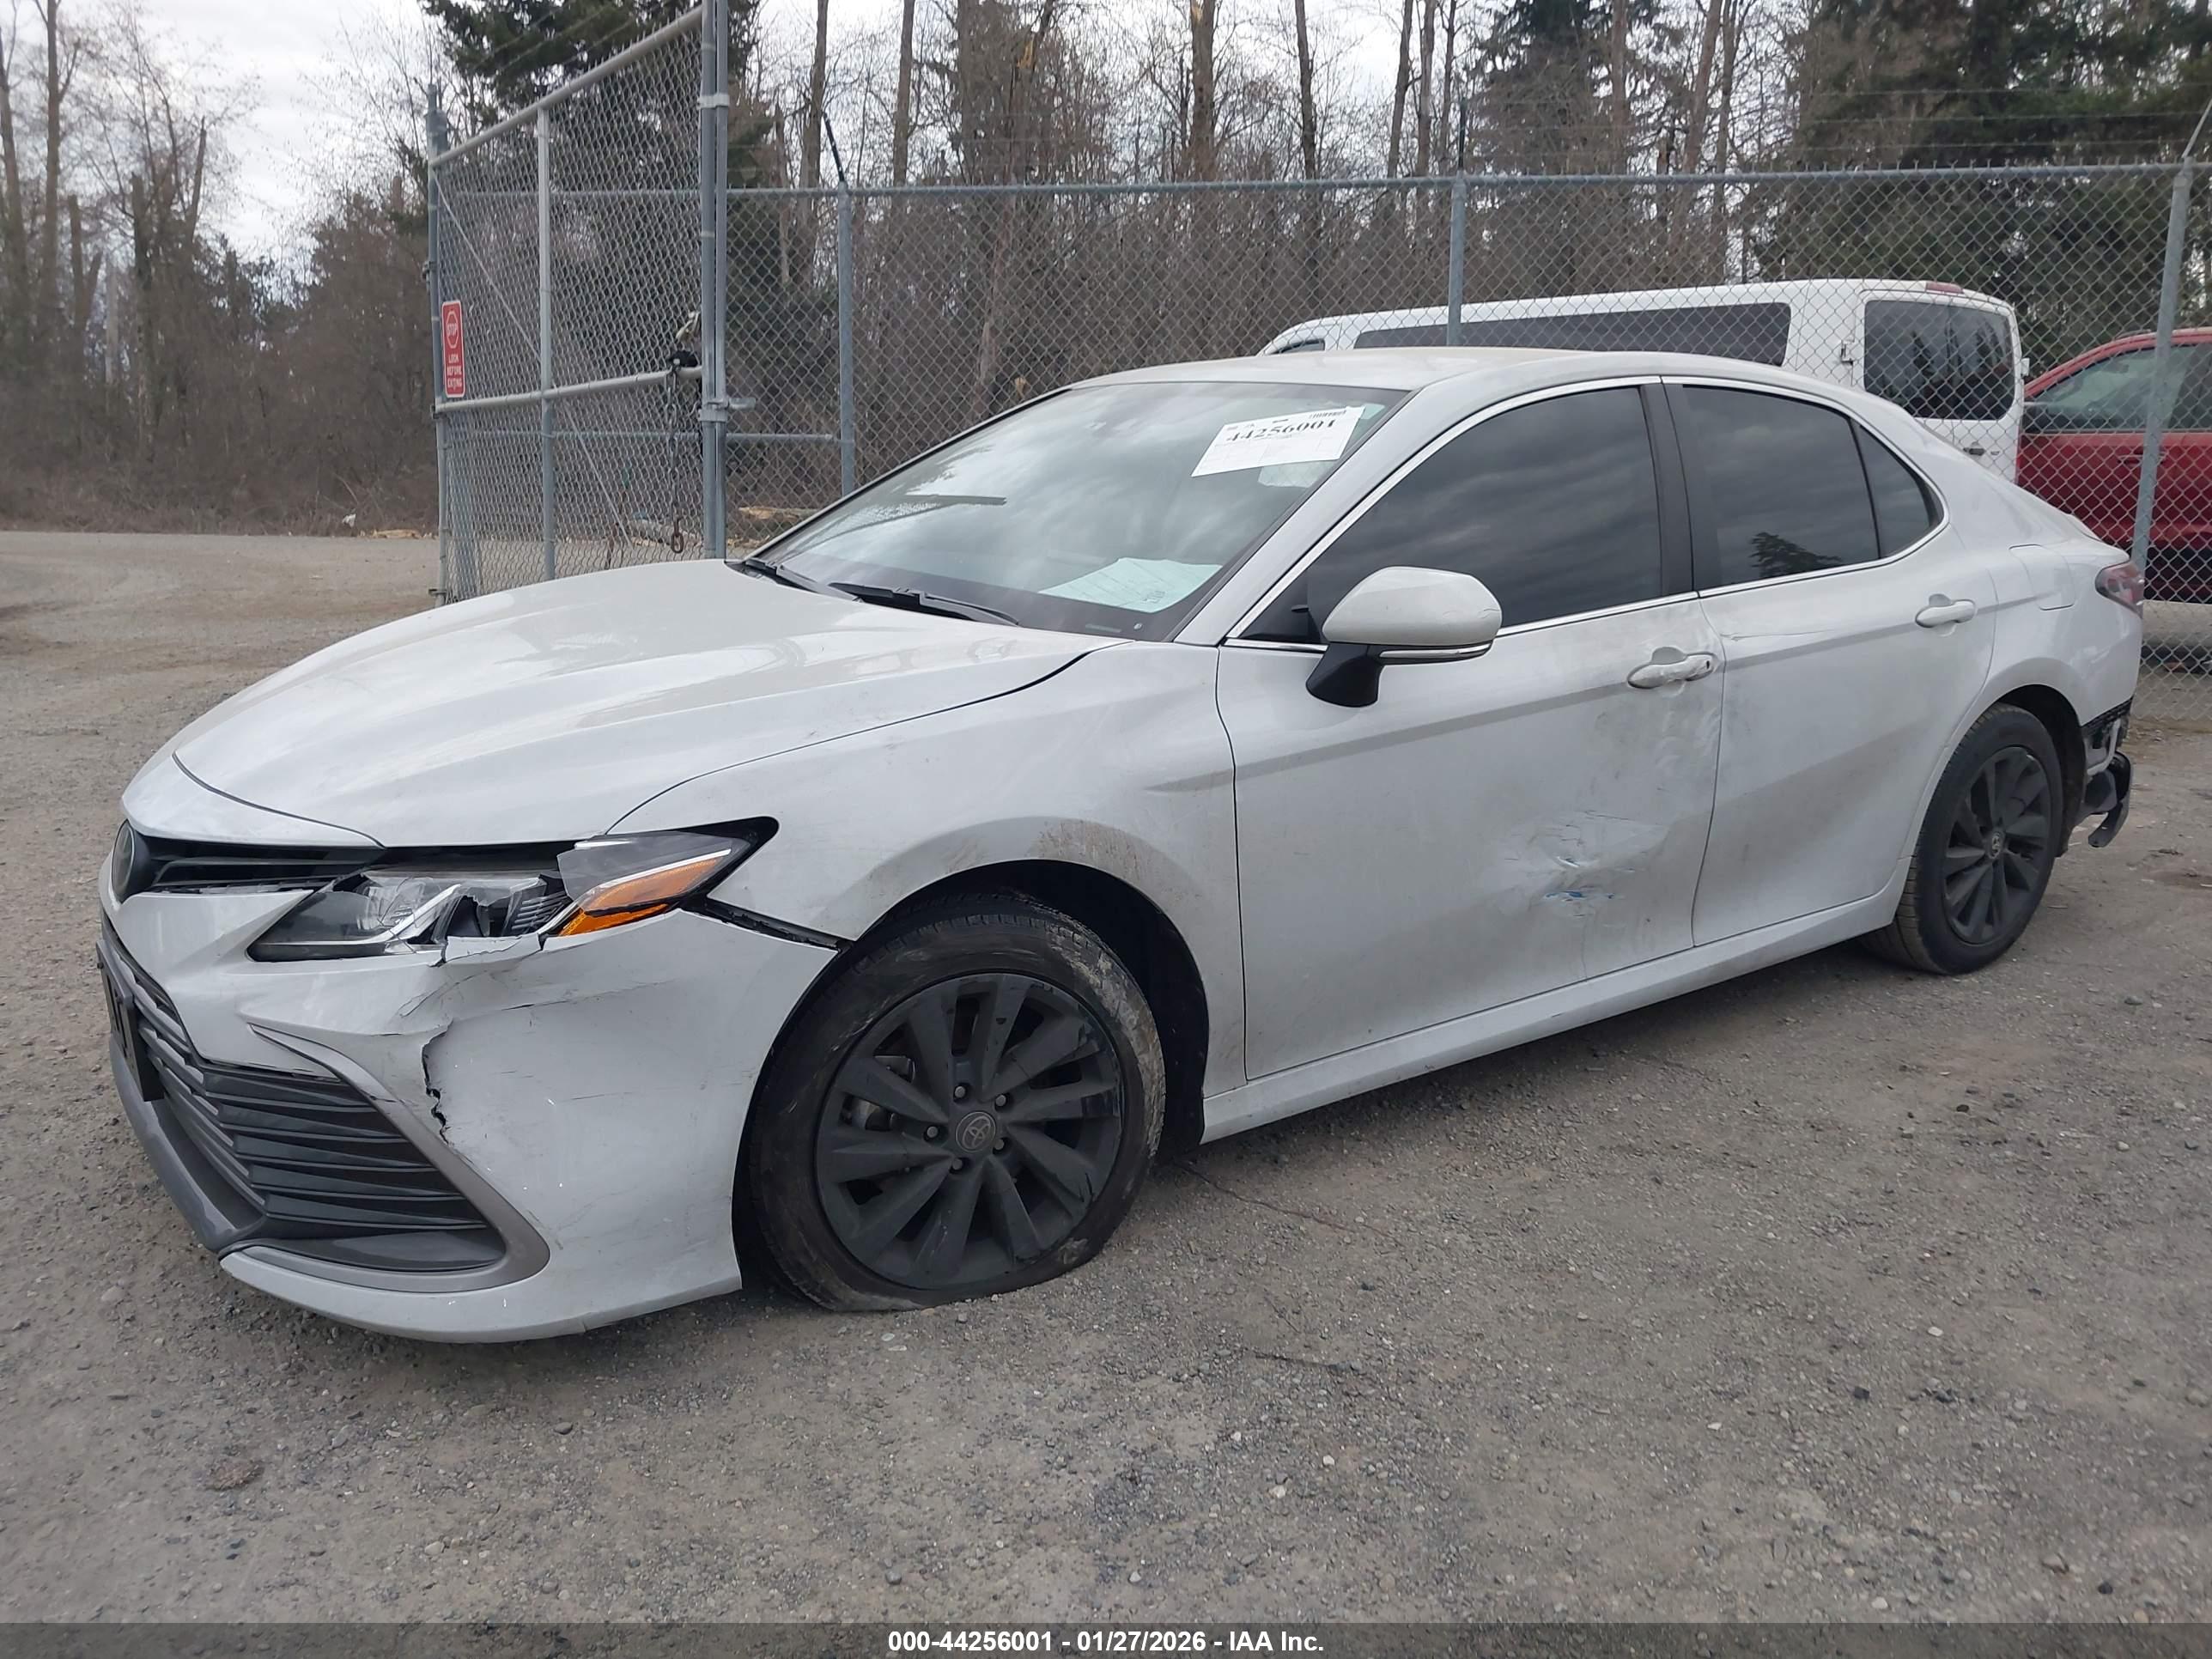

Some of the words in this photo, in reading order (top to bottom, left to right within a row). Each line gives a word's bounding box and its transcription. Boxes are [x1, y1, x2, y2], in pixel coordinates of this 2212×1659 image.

[447, 323, 458, 337] STOP
[447, 365, 462, 375] BEFORE
[1226, 418, 1336, 441] 44256001
